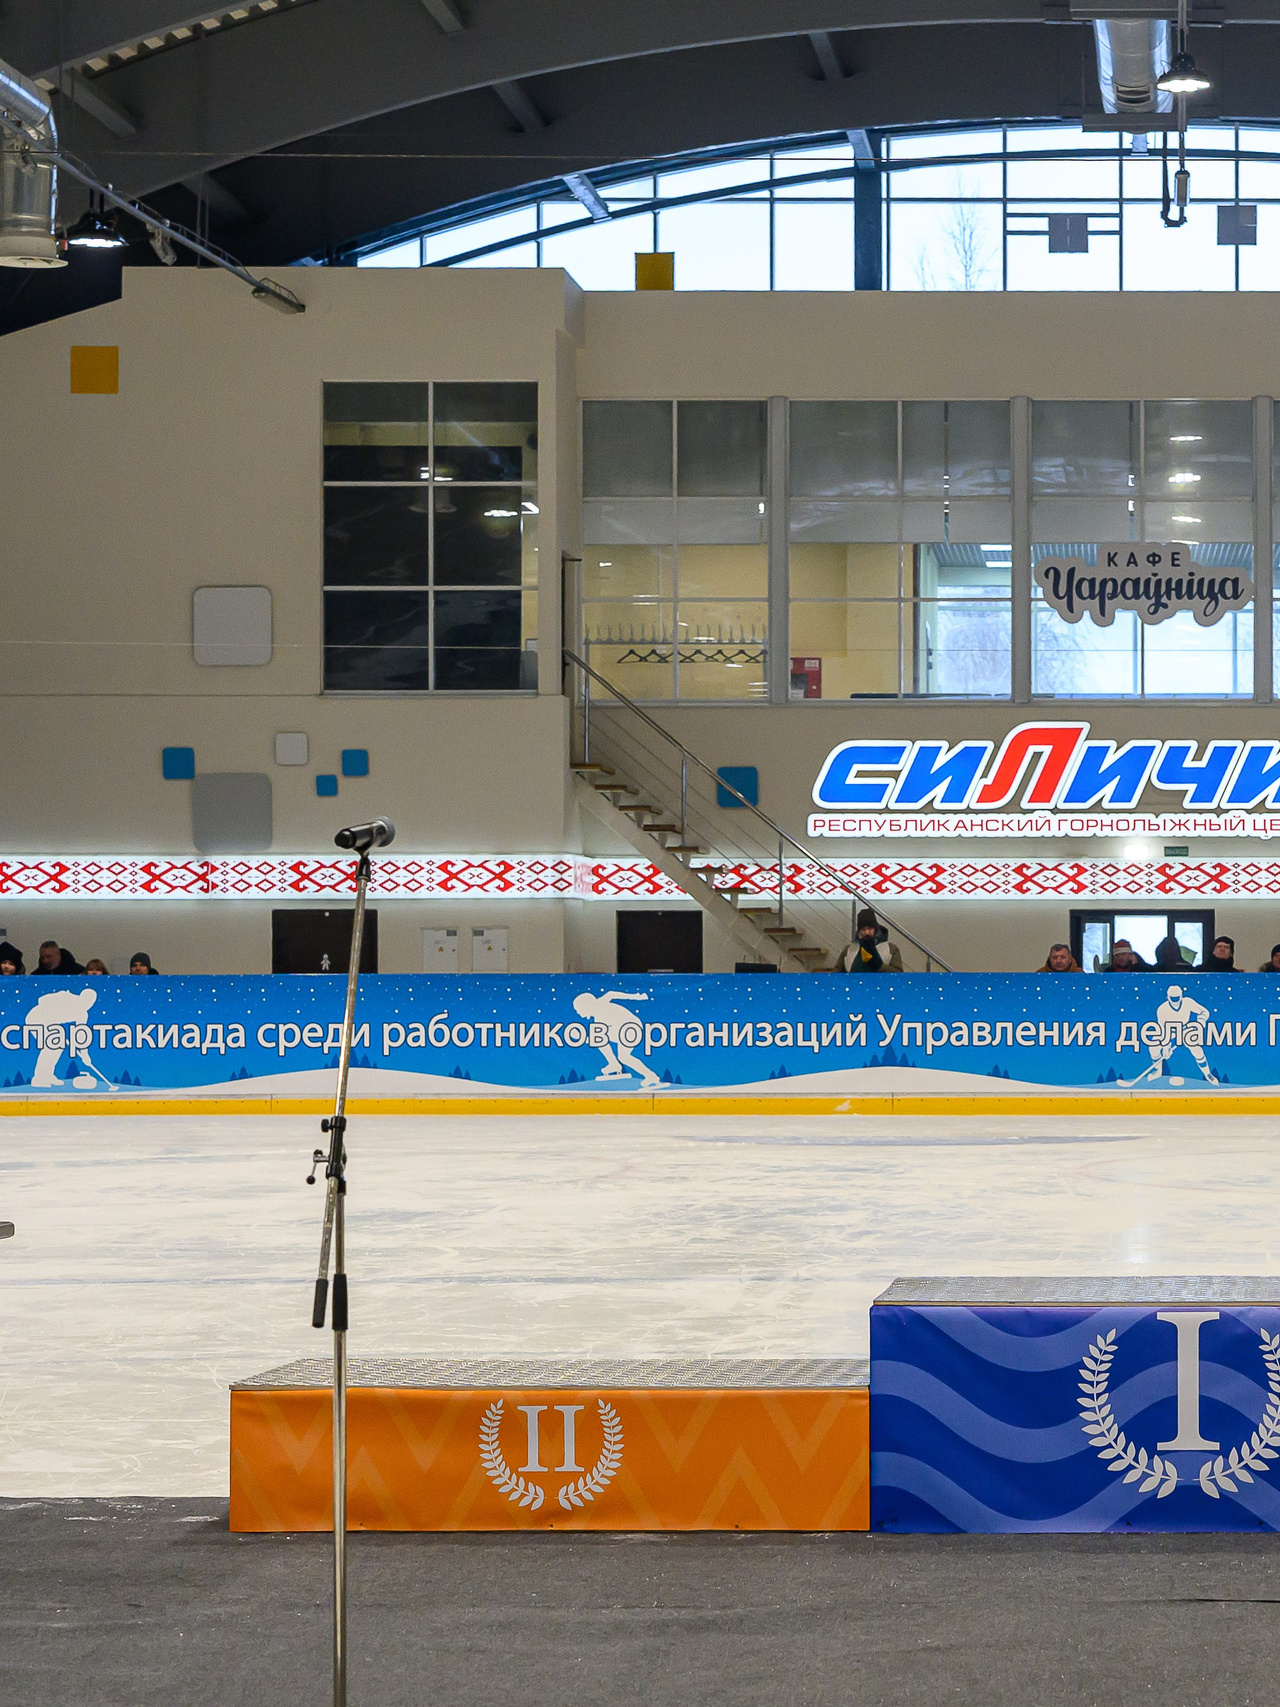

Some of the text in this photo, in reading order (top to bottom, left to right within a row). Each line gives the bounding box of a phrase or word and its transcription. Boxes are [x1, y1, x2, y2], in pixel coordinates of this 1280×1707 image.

[1107, 551, 1181, 567] КАФЕ
[1043, 566, 1245, 618] Чараўніца
[813, 814, 1052, 832] РЕСПУБЛИКАНСКИЙ
[1057, 814, 1246, 832] ГОРНОЛЫЖНЫЙ
[0, 1022, 246, 1058] спартакиада
[256, 1022, 370, 1057] среди
[382, 1012, 609, 1057] работников
[618, 1013, 867, 1056] организаций
[876, 1013, 1103, 1055] Управления
[1115, 1020, 1258, 1053] делами
[1156, 1311, 1220, 1451] I
[517, 1405, 585, 1472] II
